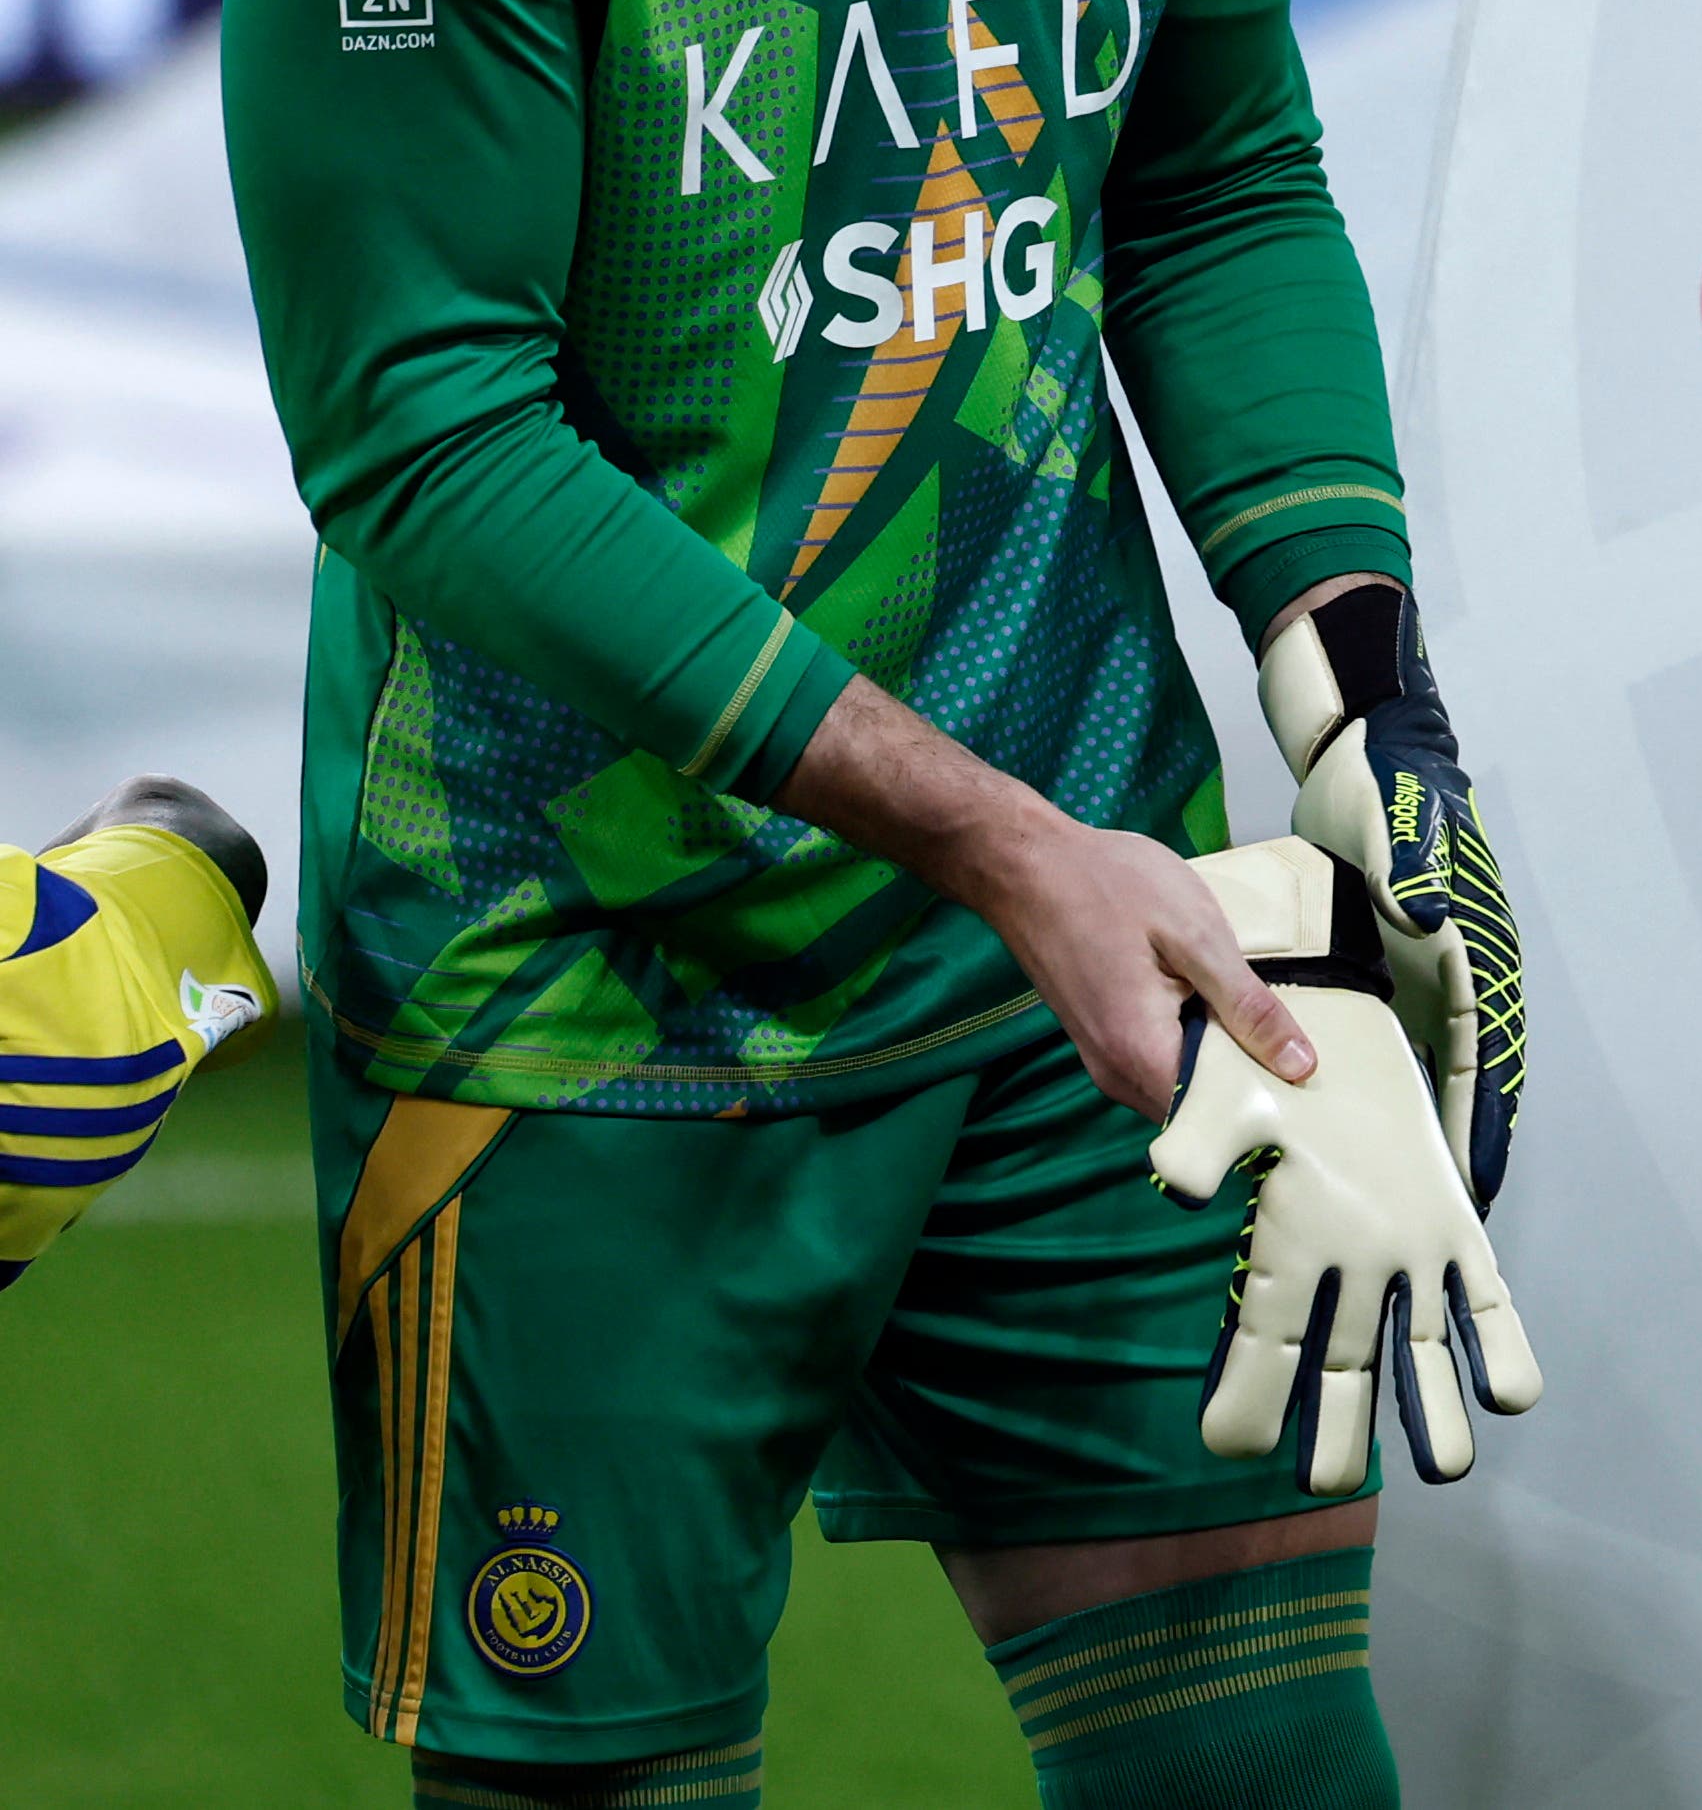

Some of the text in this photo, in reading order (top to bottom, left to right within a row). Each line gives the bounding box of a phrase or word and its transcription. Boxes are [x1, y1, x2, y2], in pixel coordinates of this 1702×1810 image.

[341, 32, 436, 52] DAZN.COM
[820, 194, 1060, 350] SHG
[1388, 771, 1426, 847] uhlsport
[511, 1555, 574, 1591] NASSR
[485, 1628, 573, 1664] FOOTBALL CLUB
